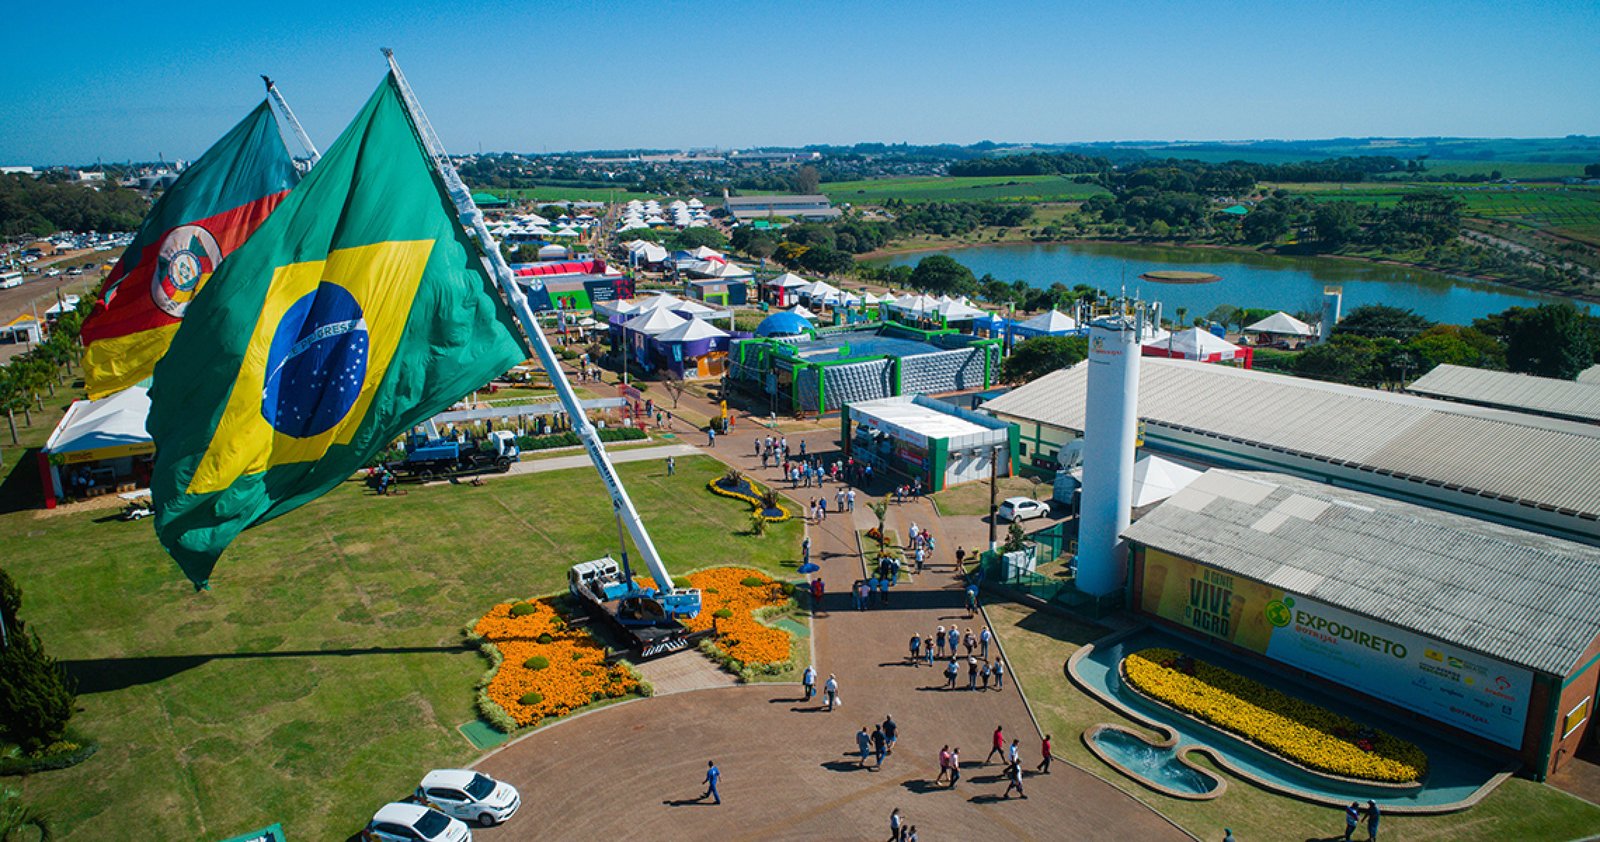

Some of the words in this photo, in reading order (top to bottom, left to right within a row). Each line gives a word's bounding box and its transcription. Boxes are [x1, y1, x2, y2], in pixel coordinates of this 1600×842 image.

[1190, 576, 1232, 617] VIVE
[1193, 608, 1229, 637] AGRO
[1296, 610, 1407, 659] EXPODIRETO
